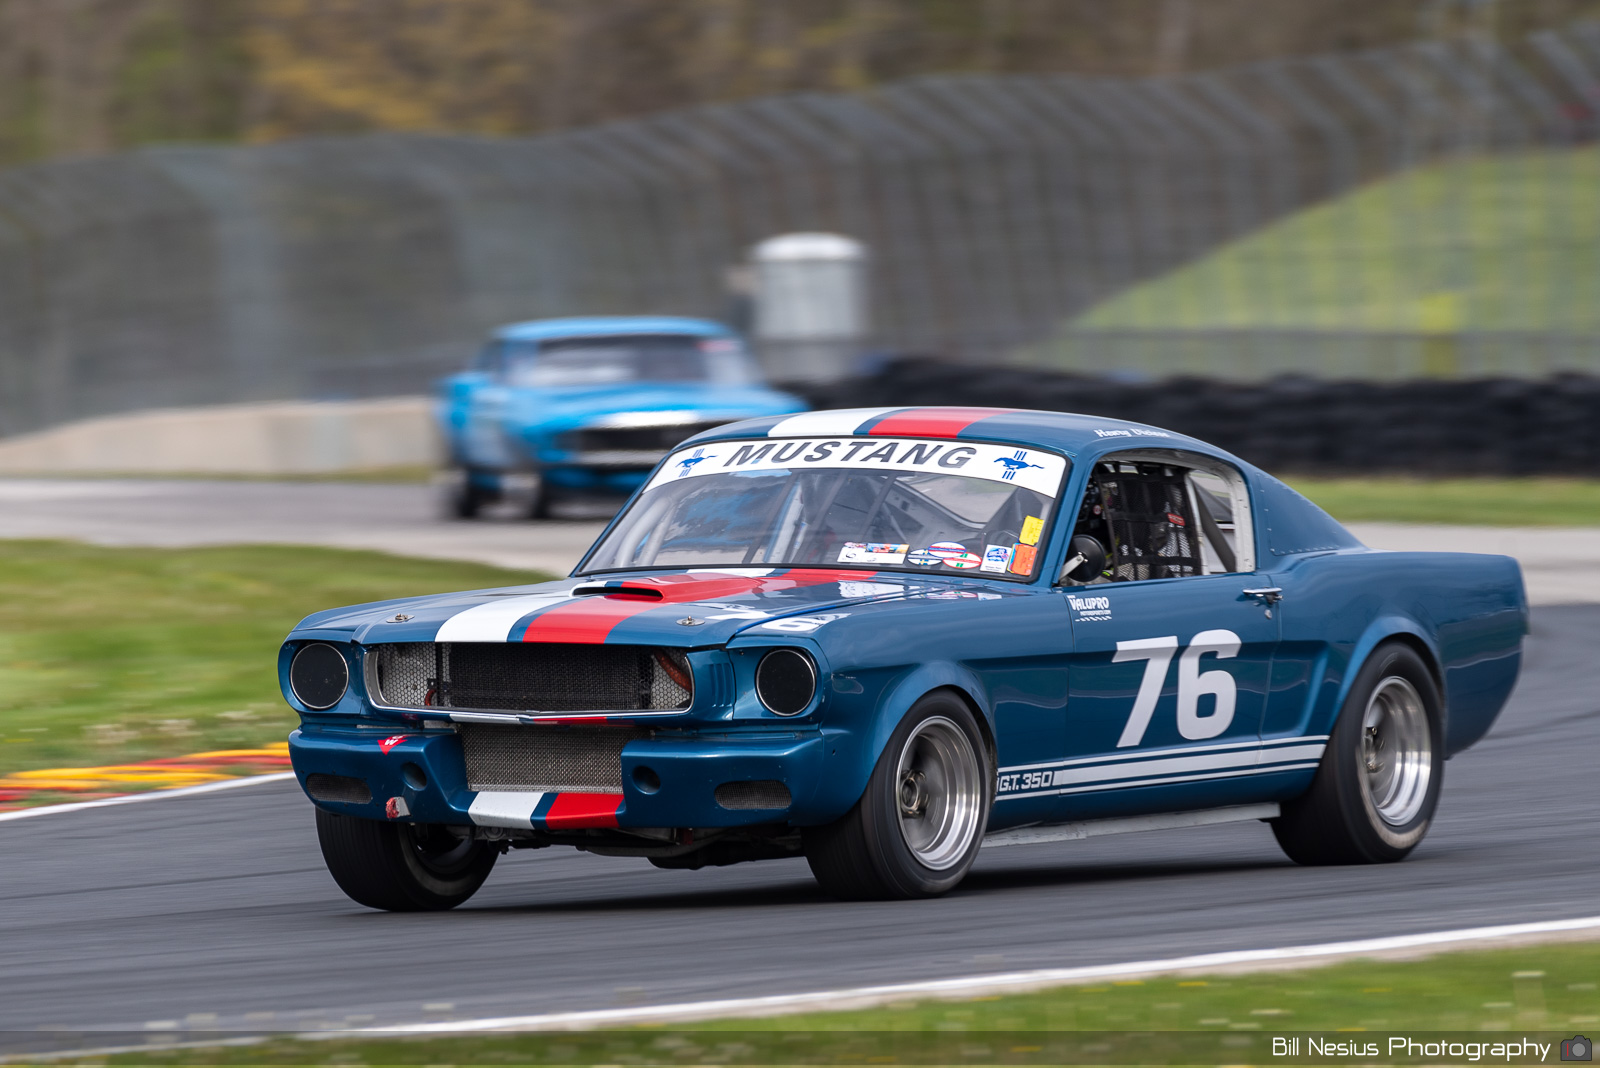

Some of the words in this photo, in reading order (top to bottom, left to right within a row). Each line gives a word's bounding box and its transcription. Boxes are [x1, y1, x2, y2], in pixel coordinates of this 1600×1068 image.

[722, 441, 977, 469] MUSTANG
[1066, 594, 1110, 611] VALUPRO
[1111, 628, 1242, 748] 76
